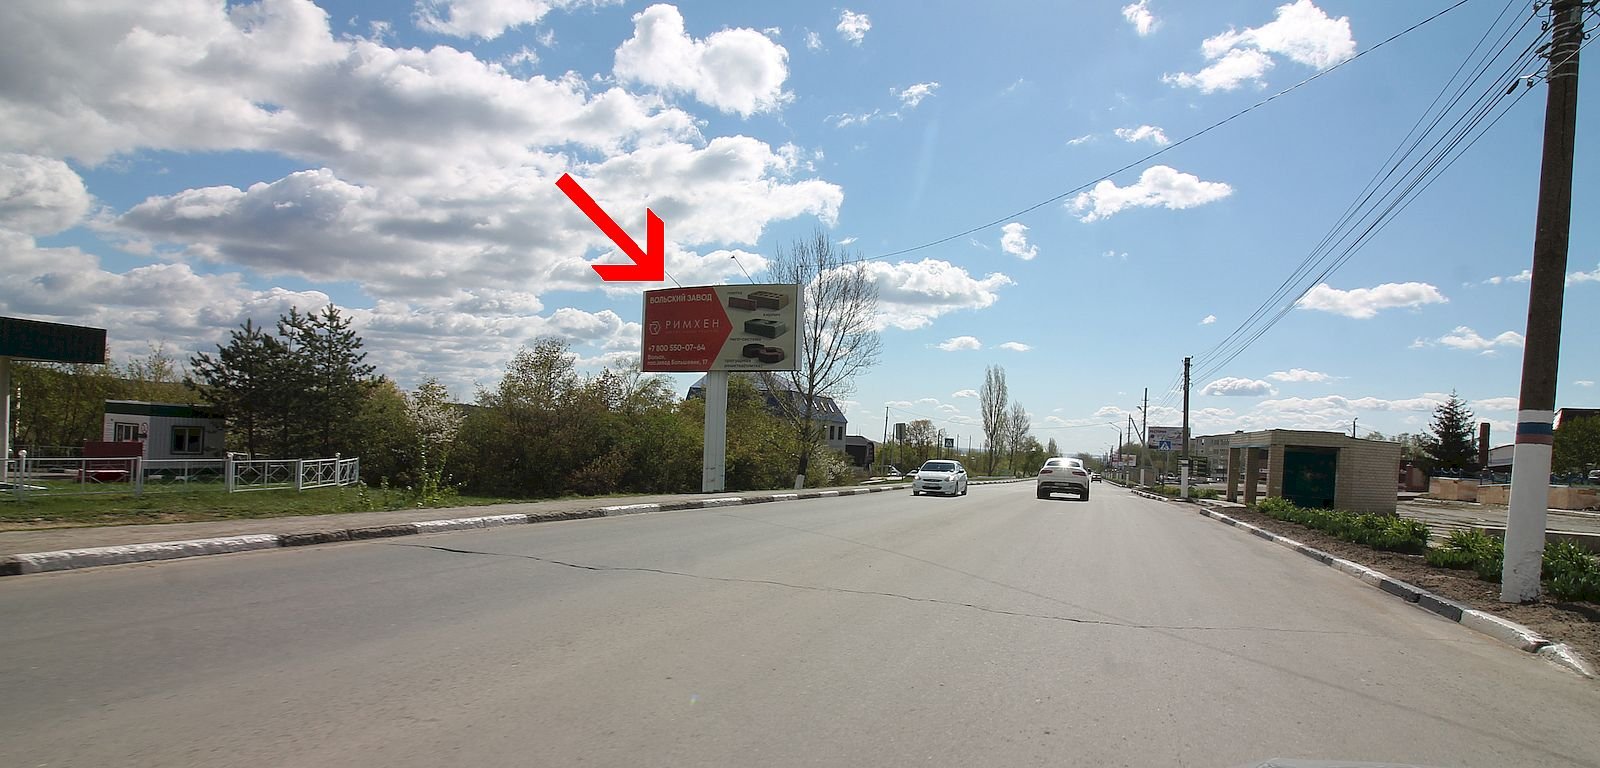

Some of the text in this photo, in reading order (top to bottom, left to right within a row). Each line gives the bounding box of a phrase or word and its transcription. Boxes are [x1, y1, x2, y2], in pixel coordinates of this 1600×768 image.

[650, 293, 712, 304] ВОЛЬСКИЙ ЗАВОД
[665, 319, 719, 329] РИМХЕН
[656, 344, 669, 352] 800
[669, 344, 706, 352] 550-07-64
